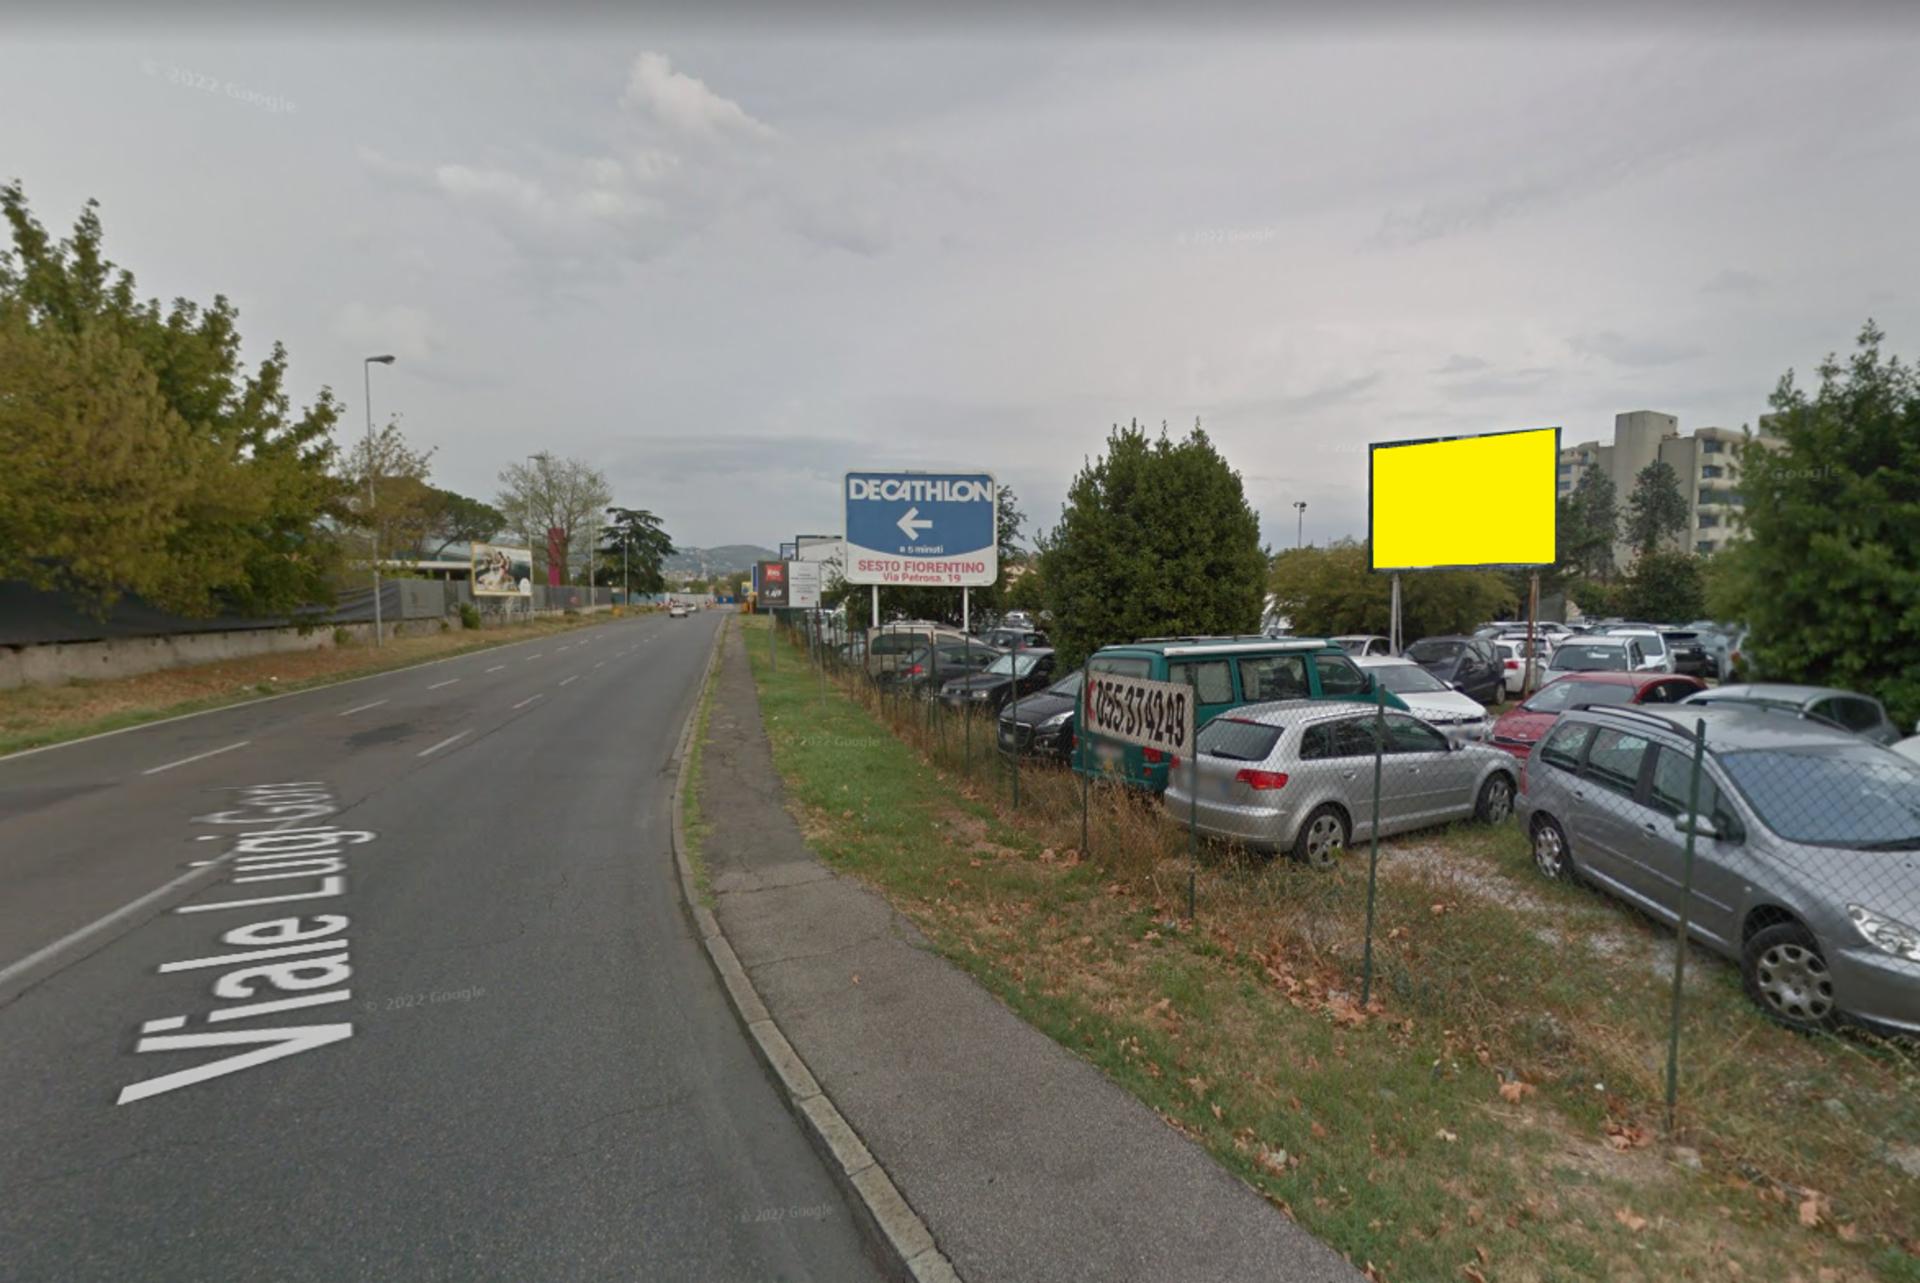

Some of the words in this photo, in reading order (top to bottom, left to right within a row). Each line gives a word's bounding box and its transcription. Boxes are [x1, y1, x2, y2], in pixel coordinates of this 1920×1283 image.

[849, 479, 993, 502] DECATHLON
[915, 544, 944, 554] minuti
[858, 560, 900, 572] SESTO
[904, 561, 985, 573] FIORENTINO
[883, 573, 899, 582] Via
[948, 574, 962, 583] 19
[1097, 680, 1185, 747] 055.374249
